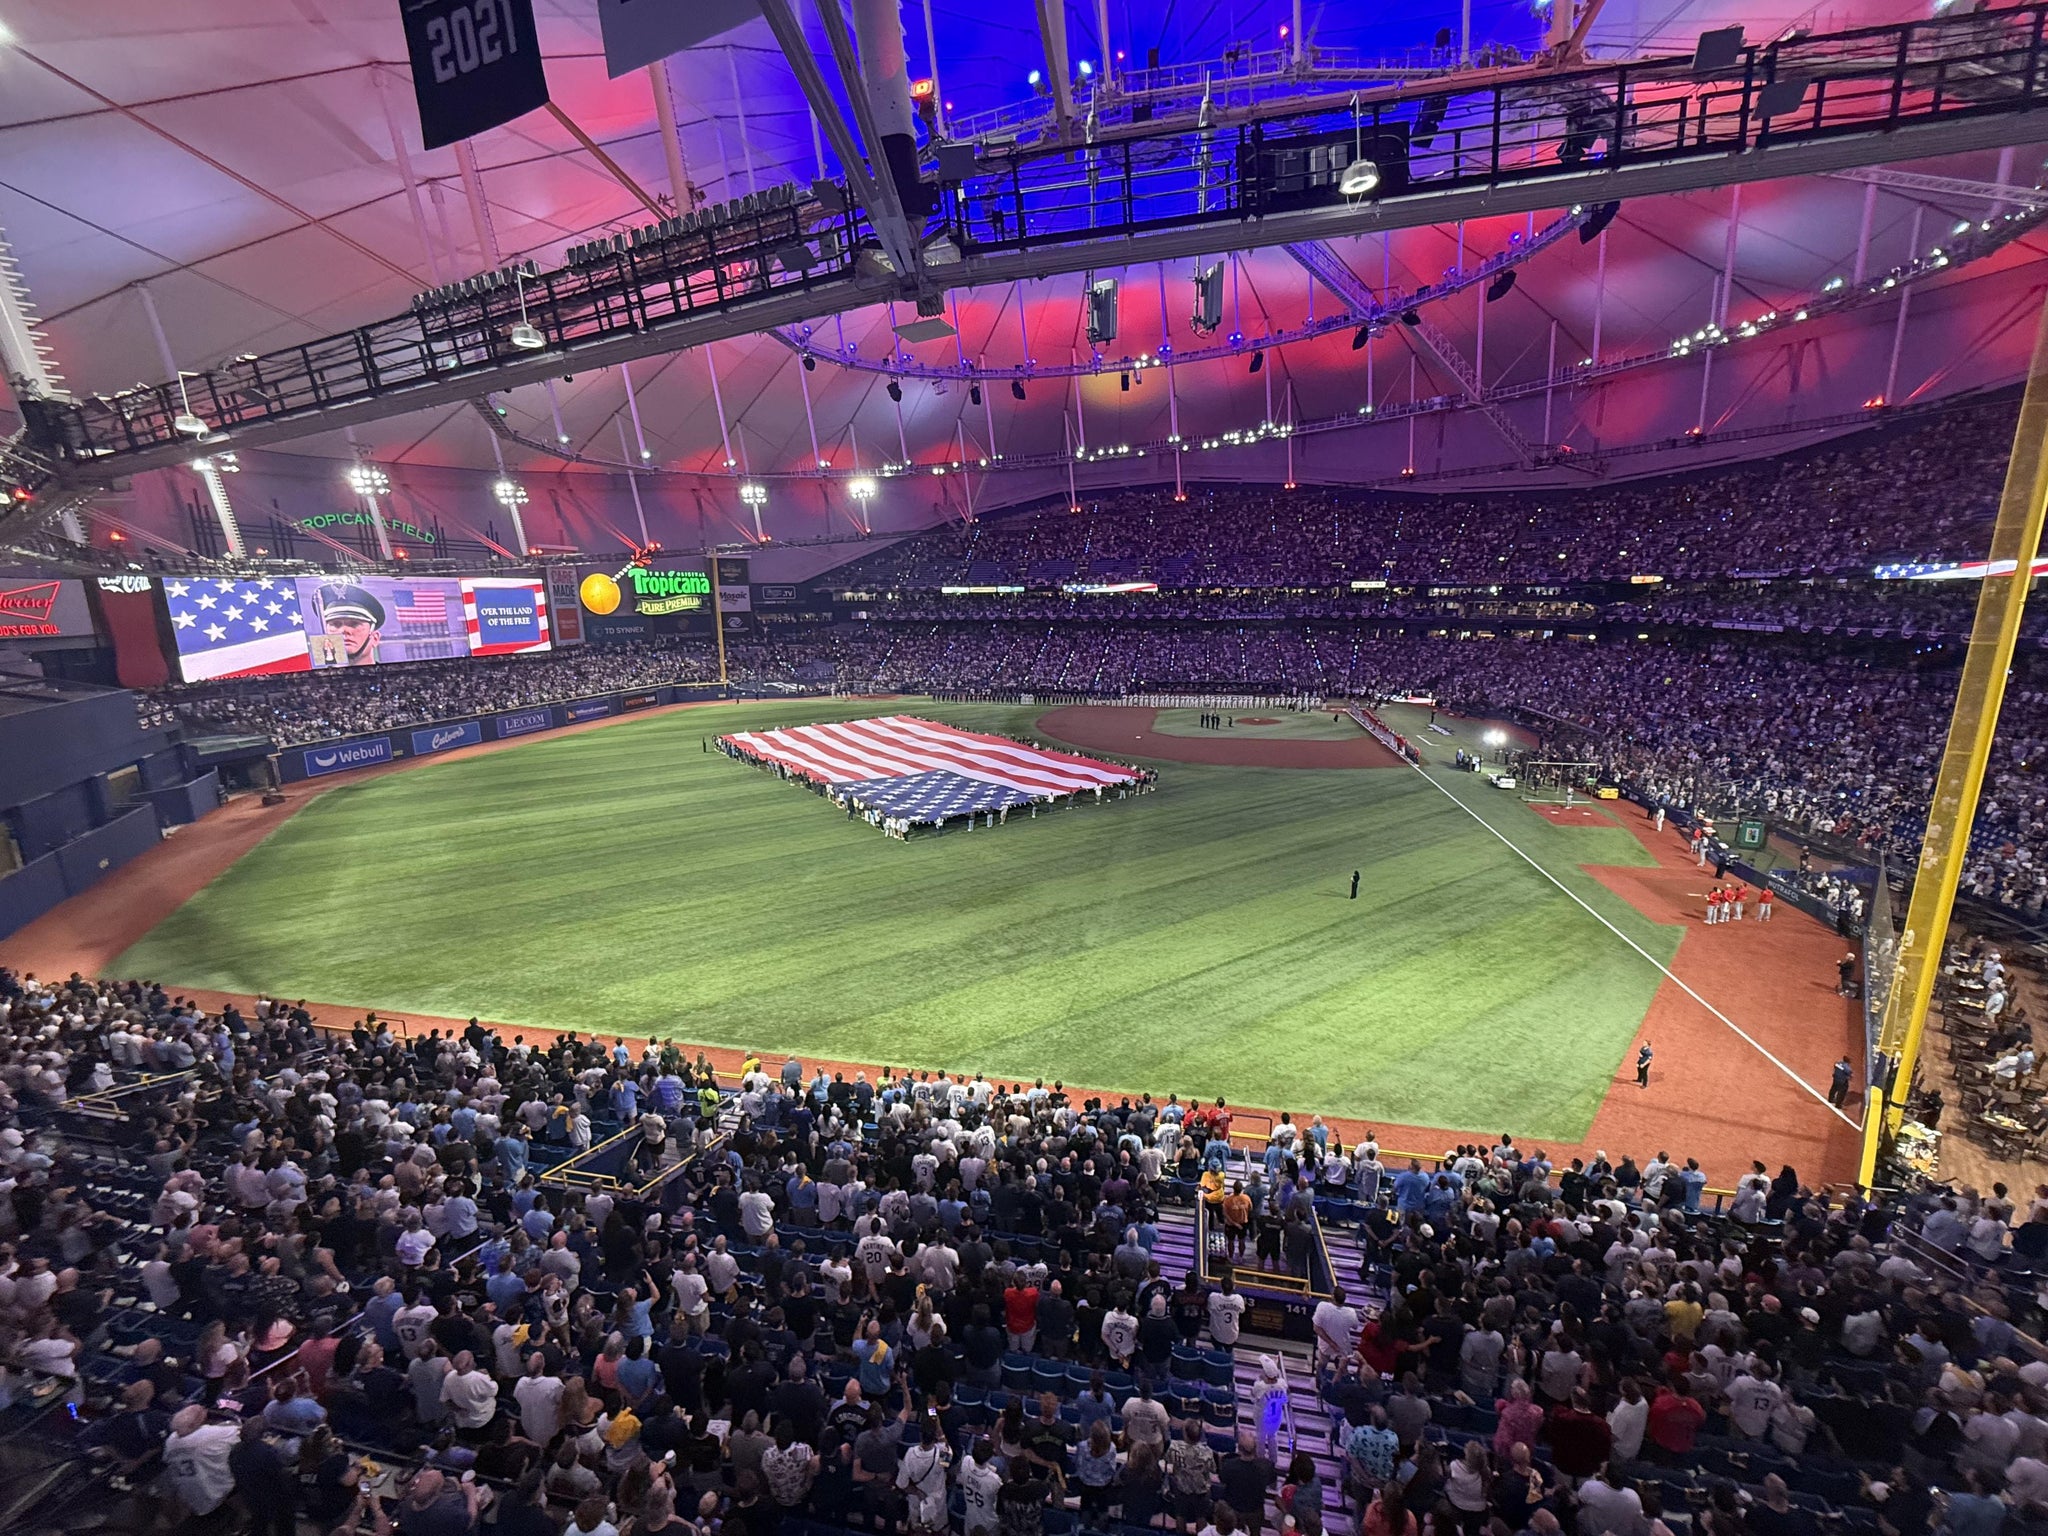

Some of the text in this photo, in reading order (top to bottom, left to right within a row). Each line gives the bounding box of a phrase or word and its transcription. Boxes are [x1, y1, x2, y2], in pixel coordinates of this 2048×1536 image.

[427, 0, 518, 83] 2021
[301, 513, 436, 545] ROPICANA FIELD
[628, 568, 710, 597] Tropicana
[553, 585, 576, 597] MADE
[719, 591, 748, 600] Mosaic
[498, 607, 513, 616] THE
[513, 606, 533, 615] LAND
[642, 597, 703, 613] PURE PREMIUM
[488, 616, 531, 626] OF THE FREE
[20, 624, 39, 635] FOR
[40, 624, 61, 635] YOU.
[616, 626, 645, 634] SYNNEX
[505, 714, 545, 730] LECOM
[339, 744, 384, 763] Webull
[1767, 880, 1800, 901] NUTRAFOL
[866, 1251, 882, 1264] 20
[1285, 1304, 1307, 1315] 141
[1224, 1312, 1232, 1324] 3
[1115, 1331, 1123, 1344] 3
[1754, 1397, 1770, 1411] 13
[966, 1486, 985, 1508] 26
